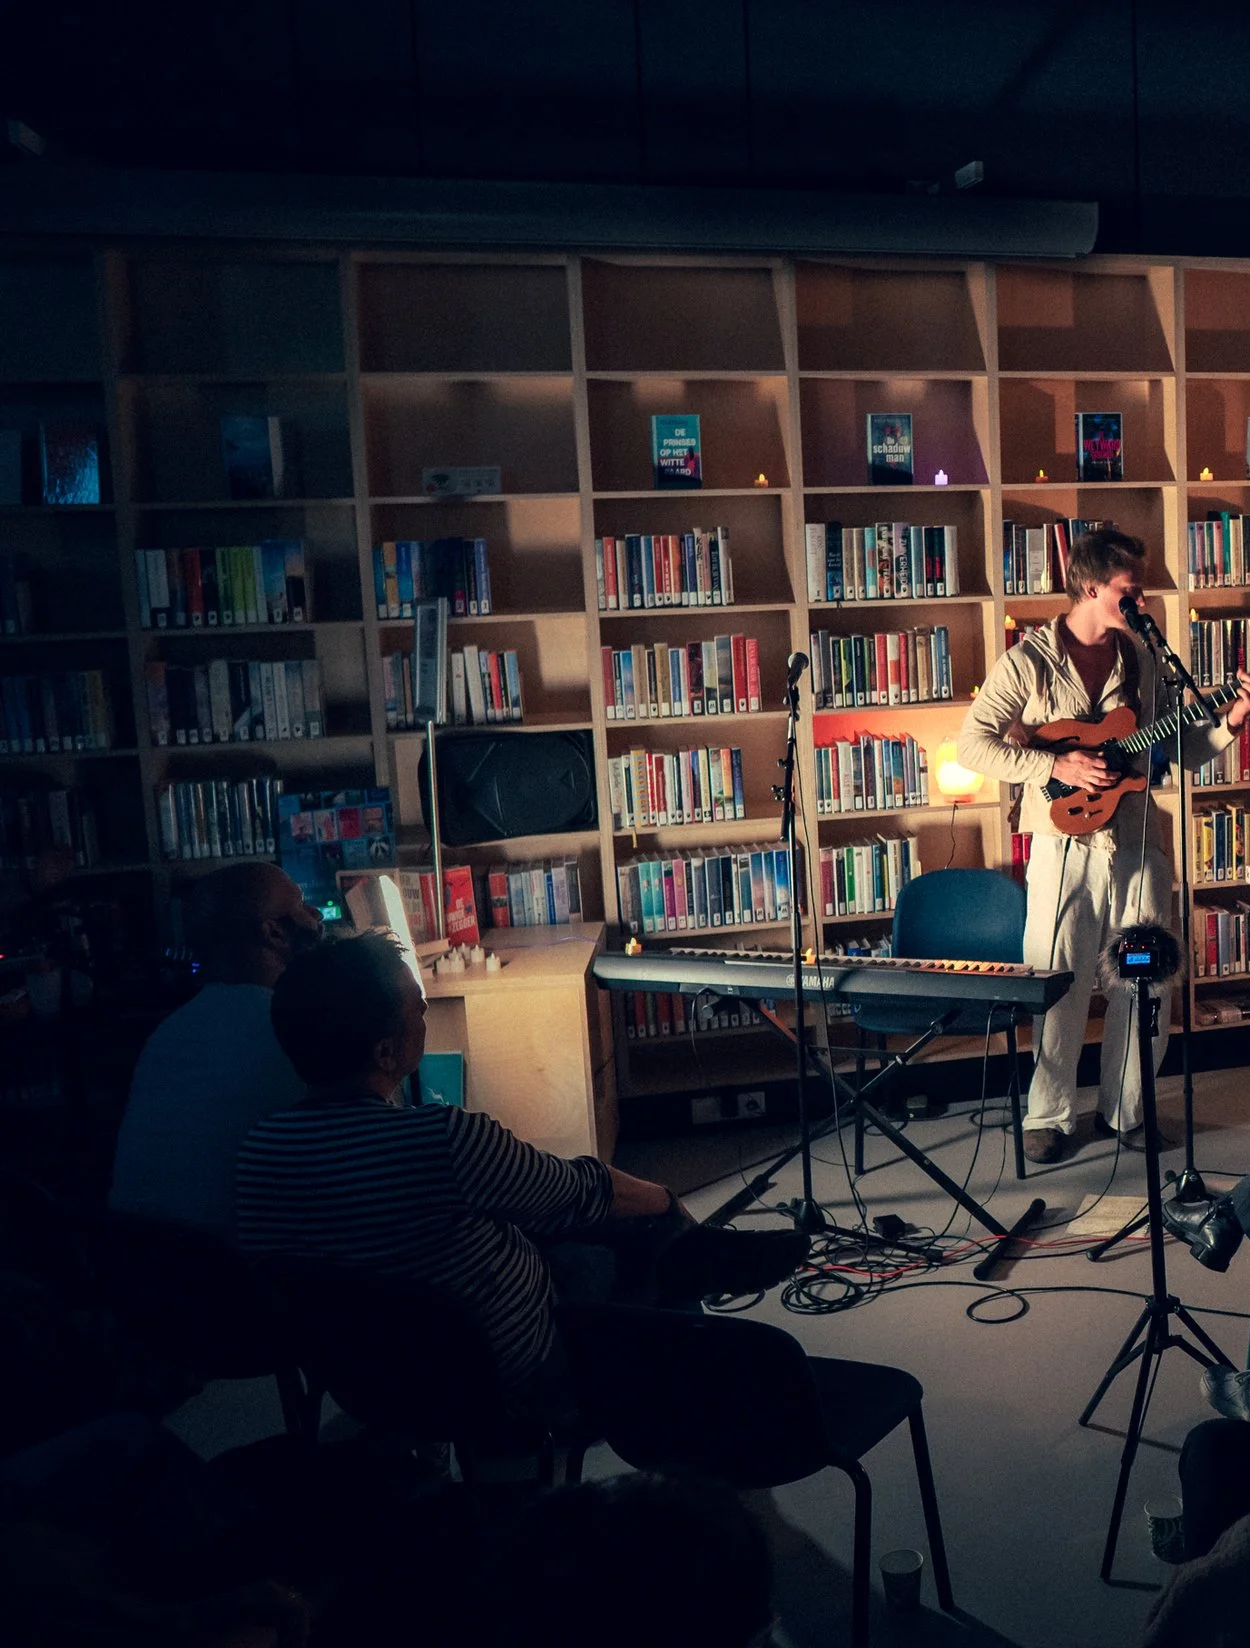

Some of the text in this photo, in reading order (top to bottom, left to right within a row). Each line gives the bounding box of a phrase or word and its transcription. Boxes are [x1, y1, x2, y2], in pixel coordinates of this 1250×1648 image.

[674, 428, 686, 437] DE
[659, 448, 688, 457] OP HET
[872, 443, 911, 454] schaduw
[660, 458, 685, 467] WITTE
[885, 453, 905, 463] man
